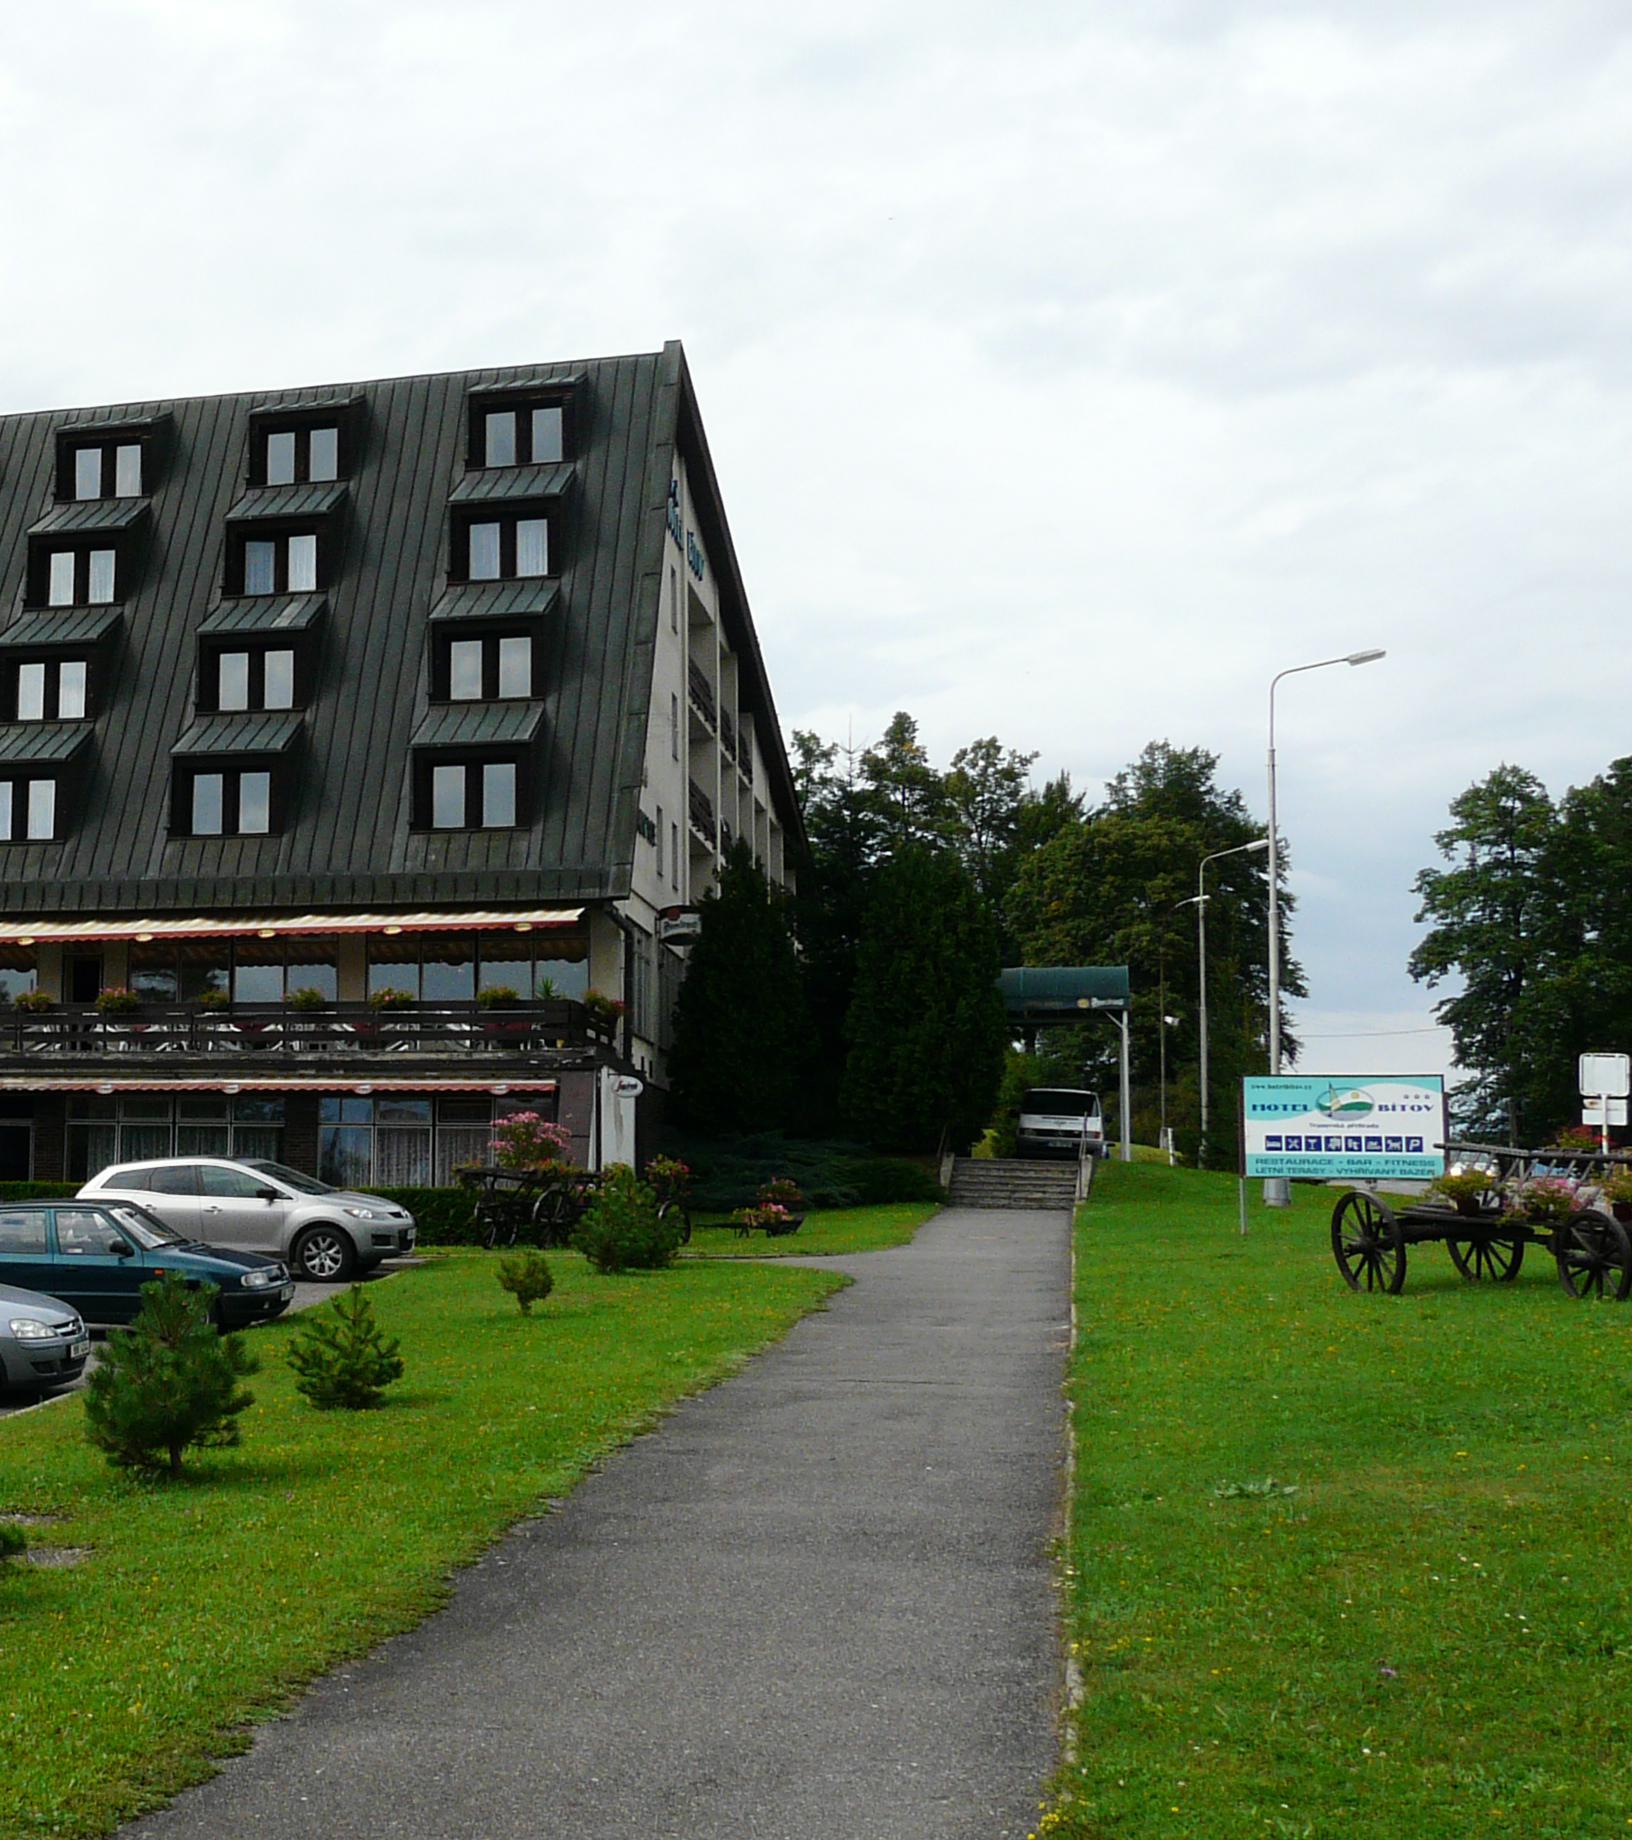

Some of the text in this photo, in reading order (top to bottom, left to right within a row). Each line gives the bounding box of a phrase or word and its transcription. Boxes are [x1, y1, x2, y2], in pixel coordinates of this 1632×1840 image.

[1251, 1103, 1311, 1112] HOTEL
[1347, 1158, 1372, 1166] BAR
[1385, 1159, 1435, 1167] FITNESS
